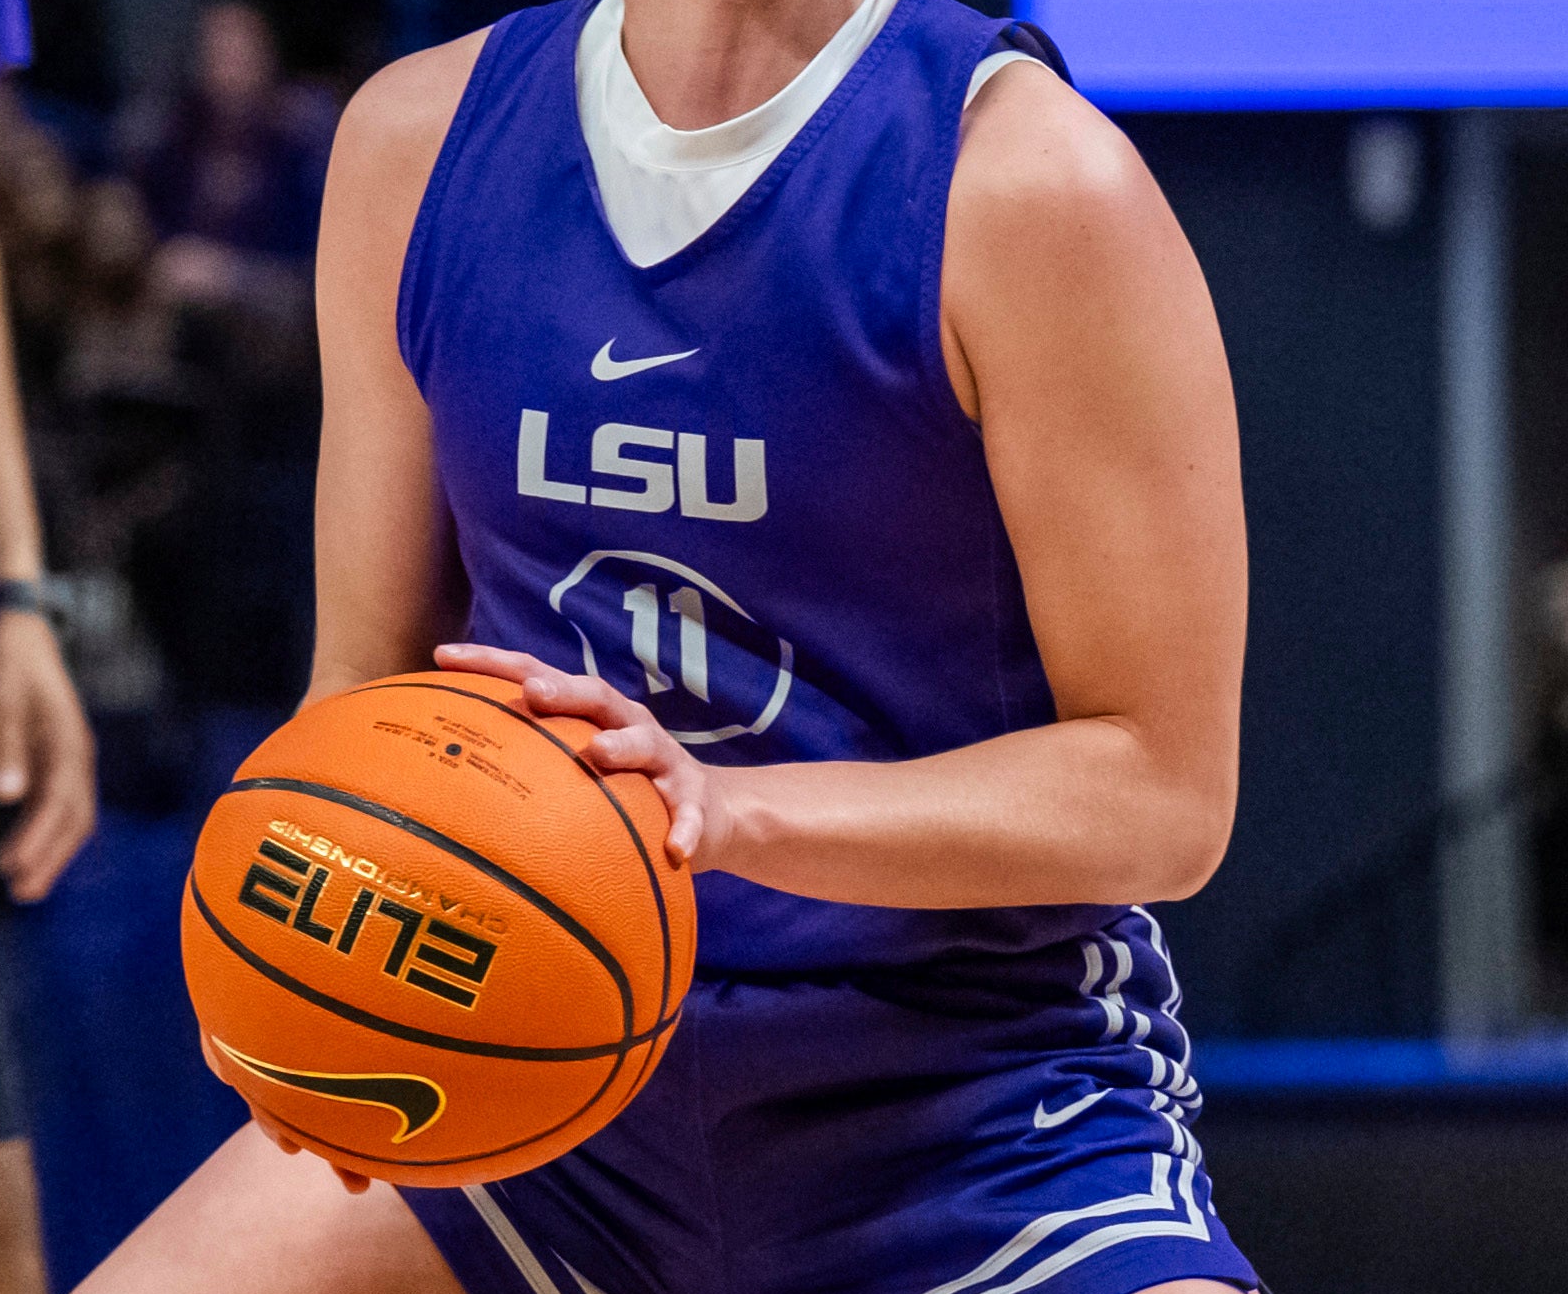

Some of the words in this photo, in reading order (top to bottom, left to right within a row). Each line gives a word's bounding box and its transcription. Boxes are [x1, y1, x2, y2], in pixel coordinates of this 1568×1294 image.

[518, 408, 768, 523] LSU
[623, 583, 711, 703] 11
[239, 838, 498, 1011] ELITE
[269, 819, 511, 937] CHAMPIONSHIP
